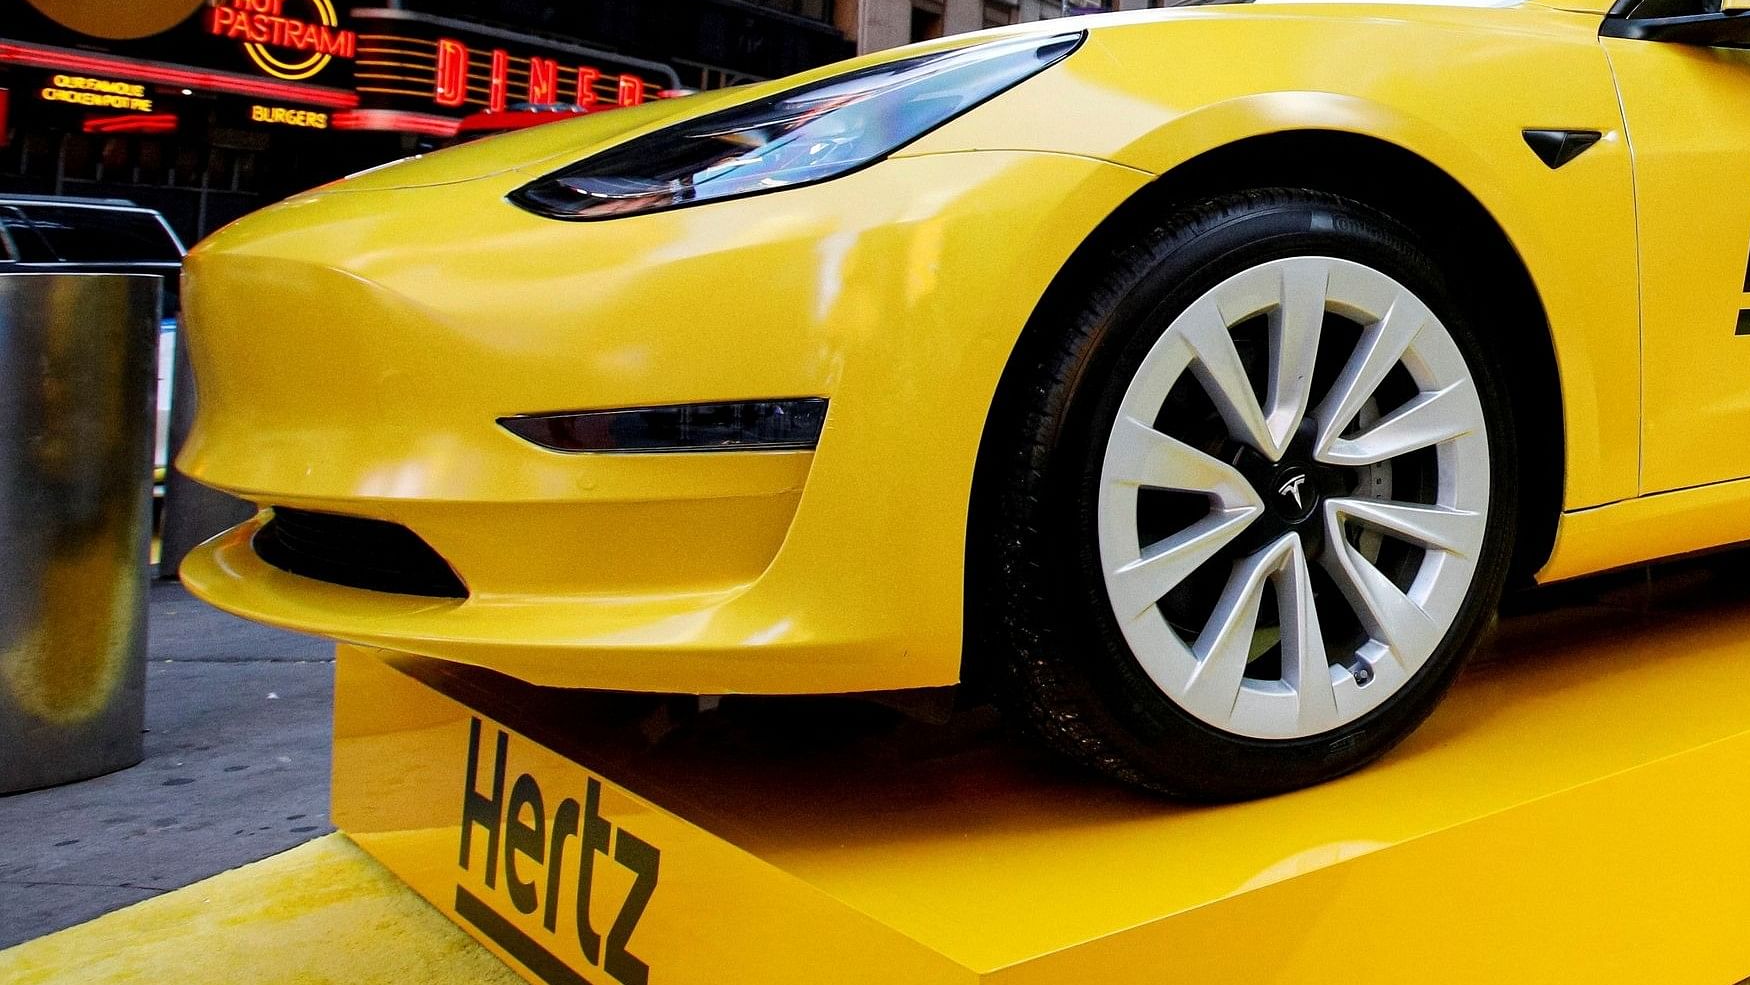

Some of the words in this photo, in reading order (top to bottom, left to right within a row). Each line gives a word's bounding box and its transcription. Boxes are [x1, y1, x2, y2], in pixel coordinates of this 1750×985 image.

[212, 6, 357, 57] PASTRAMI
[252, 104, 327, 129] BURGERS
[458, 716, 661, 985] Hertz
